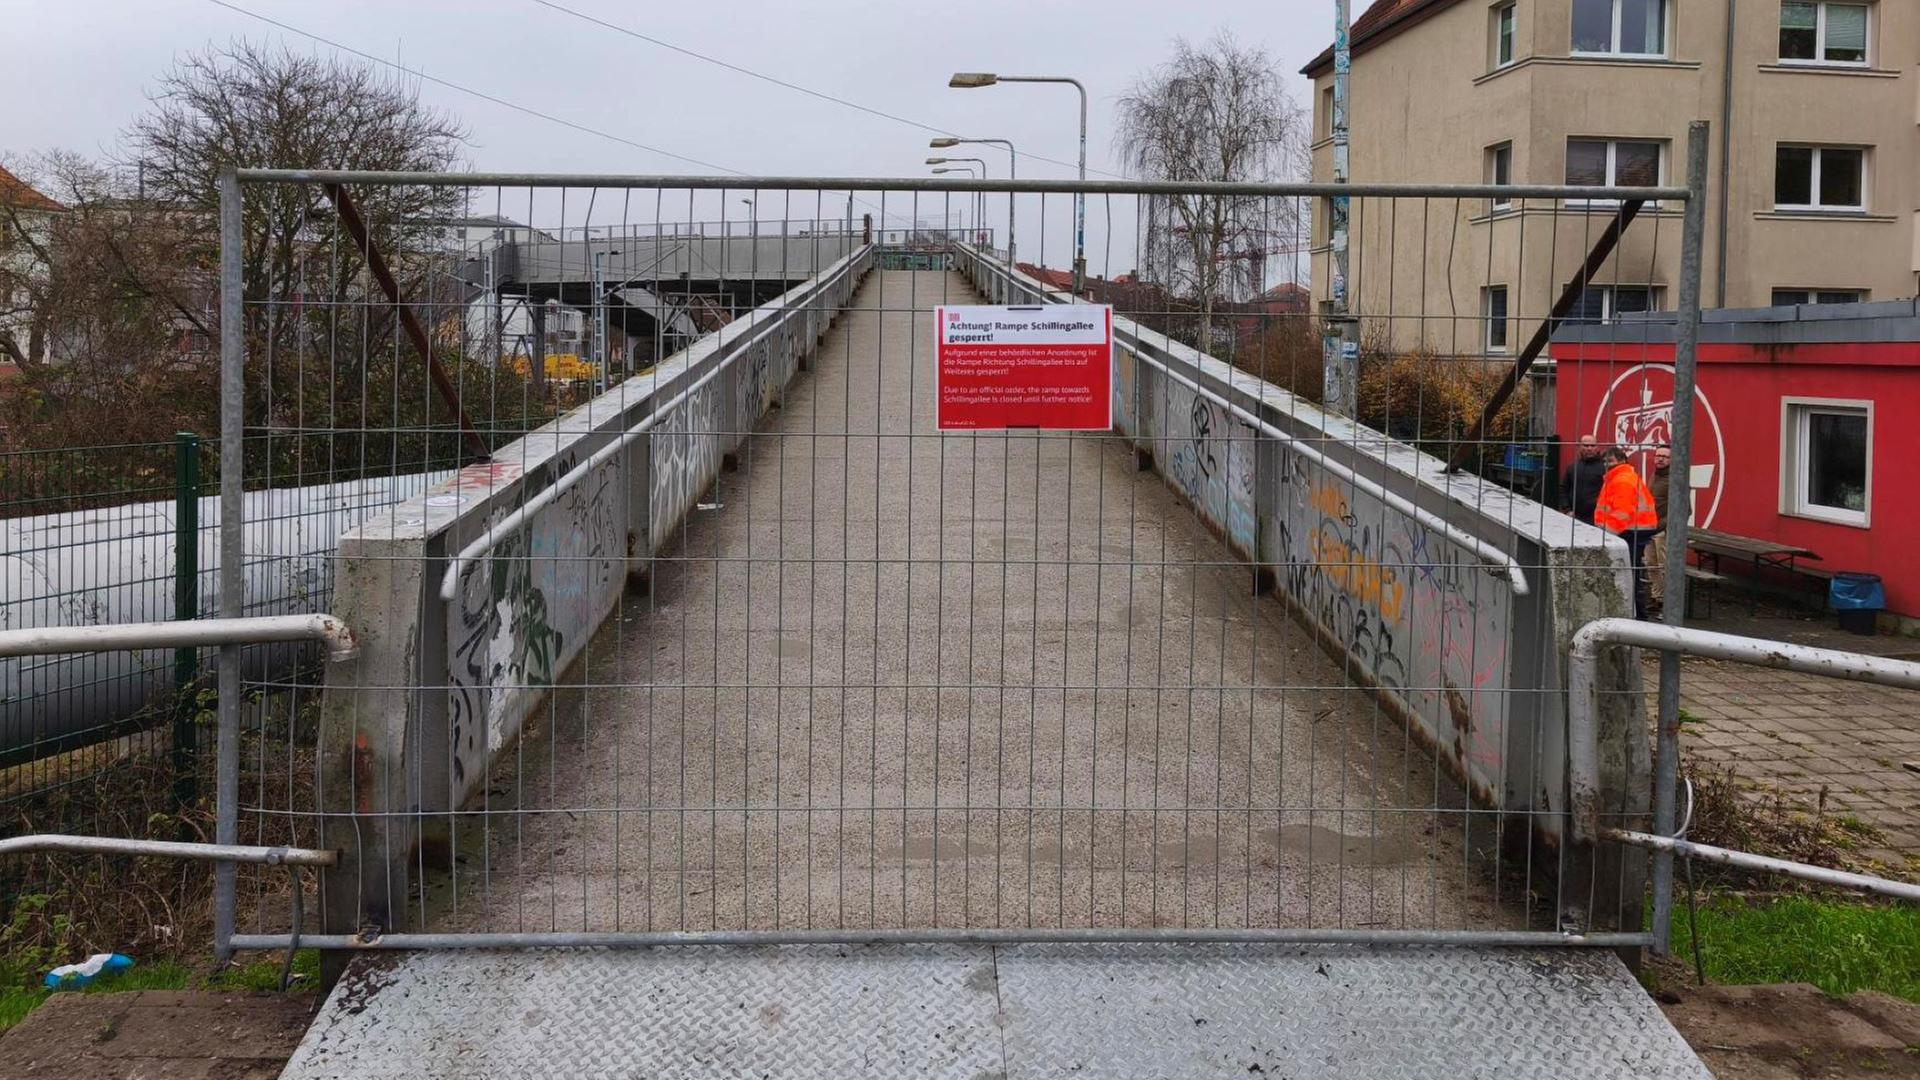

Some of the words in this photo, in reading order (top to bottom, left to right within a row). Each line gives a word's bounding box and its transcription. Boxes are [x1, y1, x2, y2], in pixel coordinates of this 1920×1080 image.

[950, 322, 992, 332] Achtung!
[995, 322, 1028, 332] Rampe
[1031, 321, 1094, 332] Schillingallee
[949, 333, 993, 343] gesperrt!
[944, 349, 978, 357] Aufgrund
[1046, 349, 1087, 357] Anordnung
[957, 359, 982, 367] Rampe
[983, 359, 1015, 367] Richtung
[1016, 358, 1063, 367] Schillingallee
[1064, 358, 1076, 366] bis
[1076, 358, 1088, 366] auf
[976, 368, 1009, 376] gesperrt!
[944, 386, 958, 394] Due
[1005, 386, 1027, 395] order,
[1061, 386, 1090, 394] towards
[944, 395, 991, 404] Schillingallee
[992, 395, 999, 403] is
[1000, 395, 1023, 403] closed
[1041, 395, 1067, 403] further
